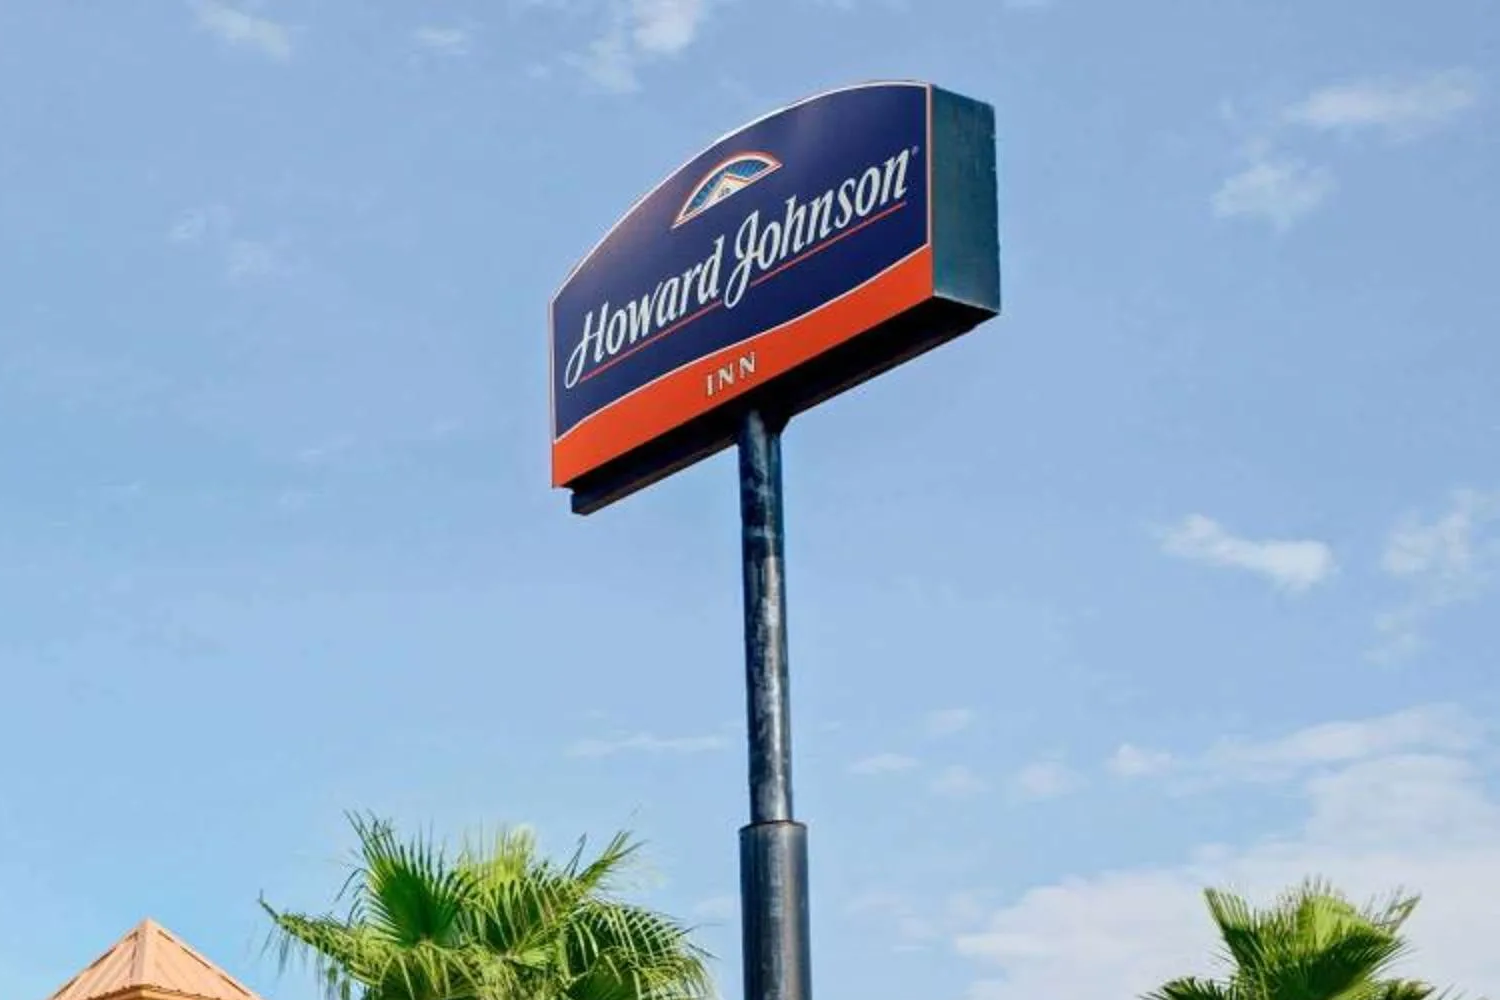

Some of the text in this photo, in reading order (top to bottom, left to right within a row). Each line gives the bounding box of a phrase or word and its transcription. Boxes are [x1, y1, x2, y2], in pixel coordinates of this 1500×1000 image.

[565, 147, 908, 389] Howard Johnson
[706, 352, 757, 396] INN
